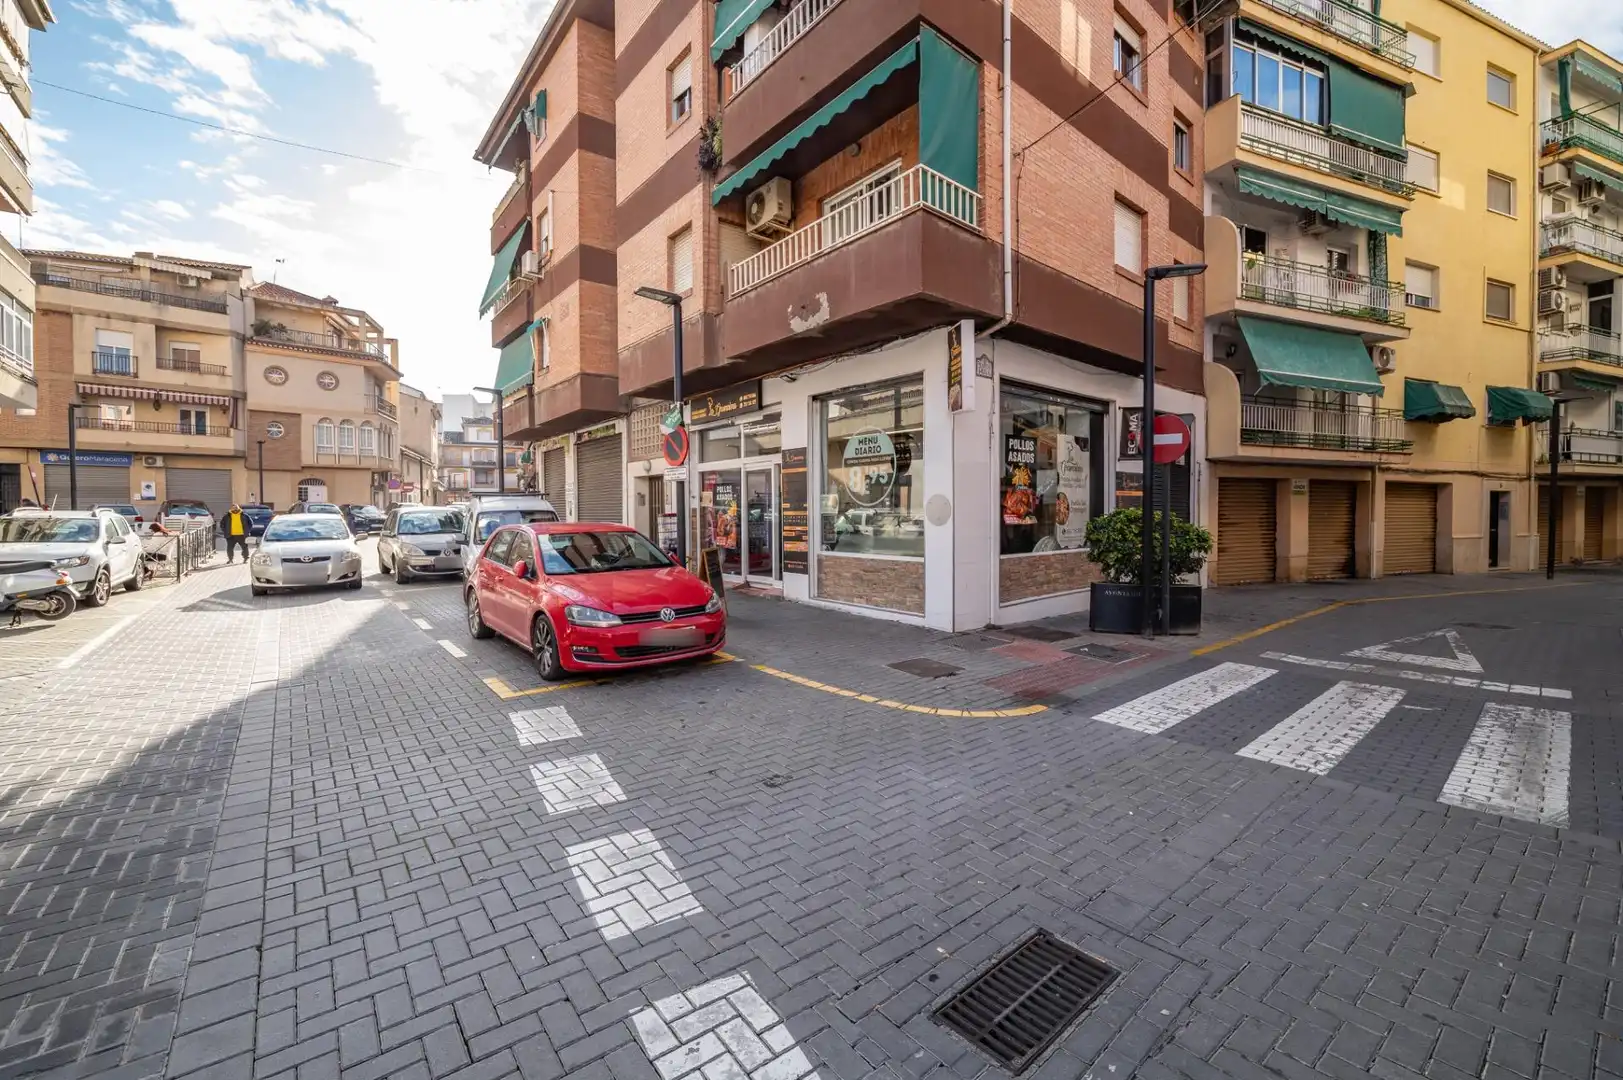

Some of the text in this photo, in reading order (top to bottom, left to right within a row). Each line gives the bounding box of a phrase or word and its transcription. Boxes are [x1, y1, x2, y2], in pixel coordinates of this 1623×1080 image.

[1008, 438, 1035, 451] POLLOS
[854, 445, 882, 456] DIARIO
[59, 454, 128, 463] QueroMaracena
[1008, 450, 1035, 464] ASADOS
[716, 485, 733, 494] POLLOS
